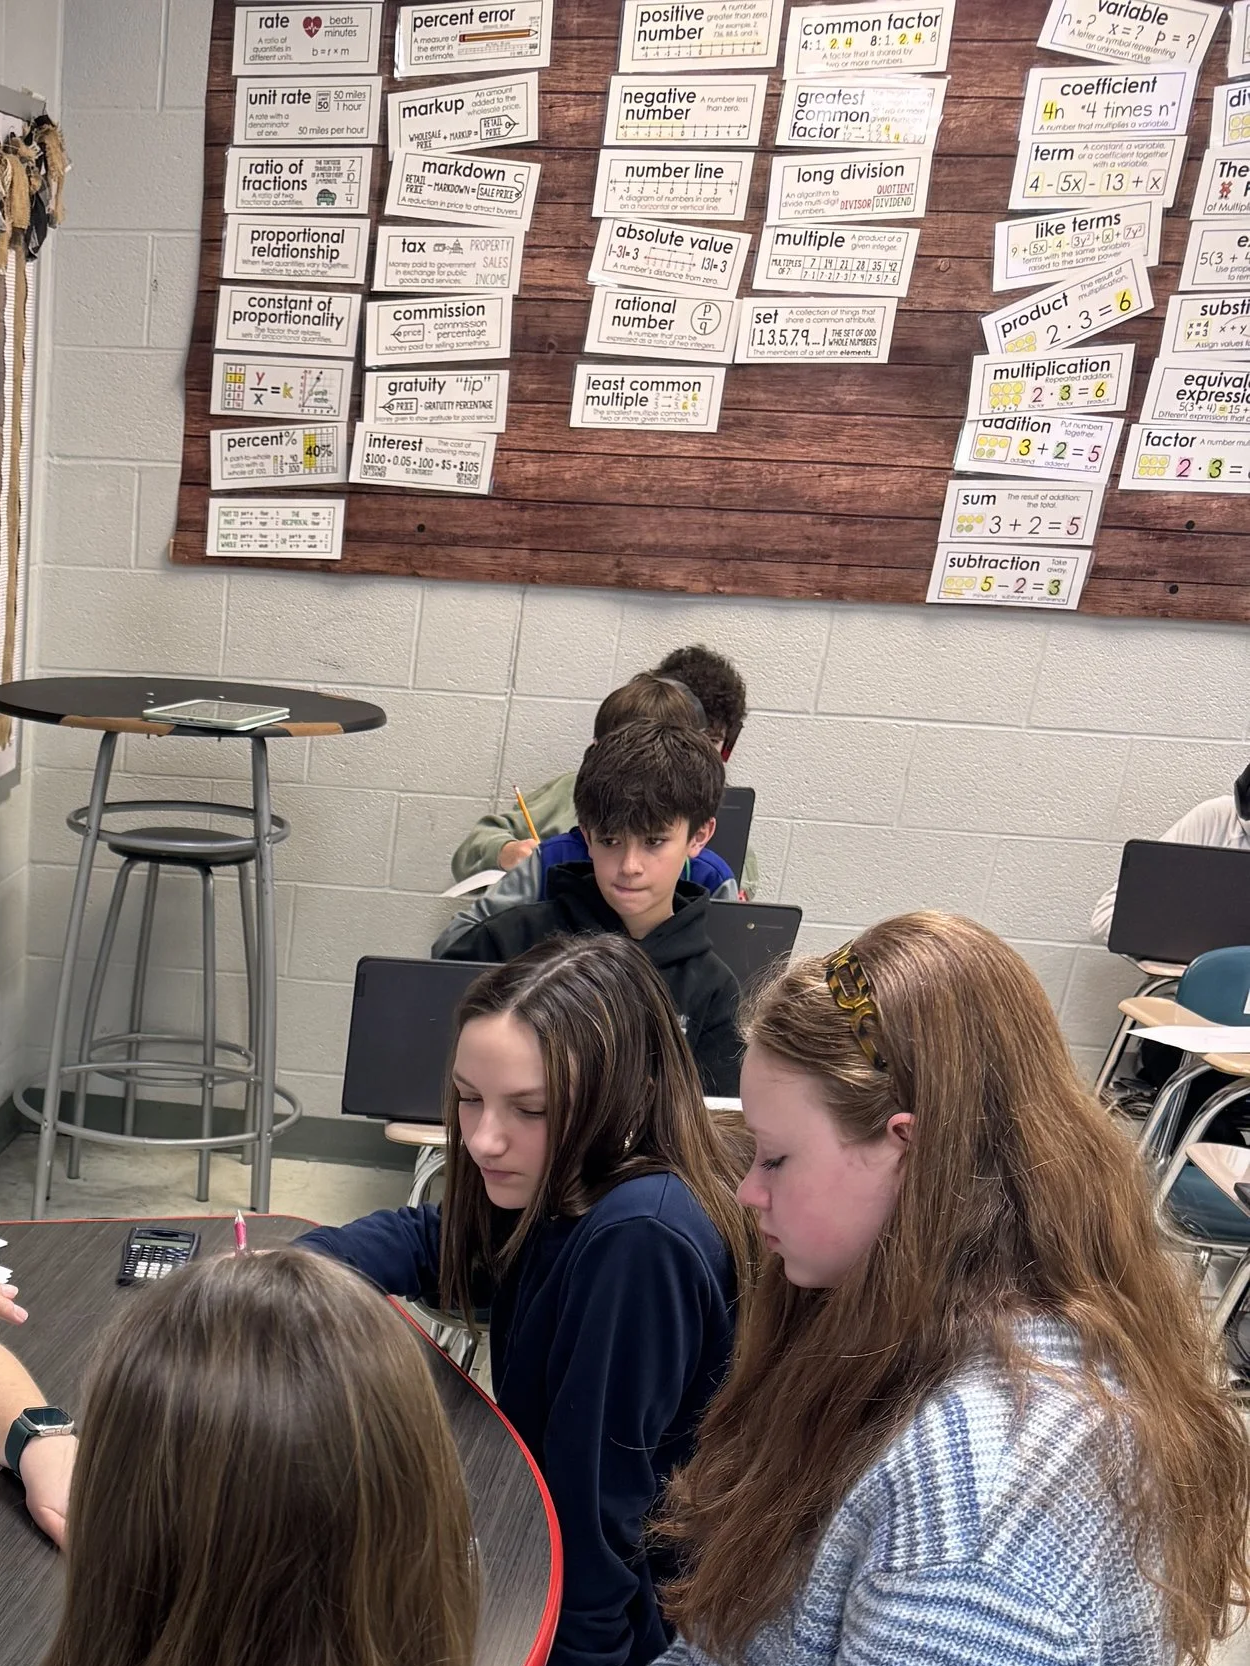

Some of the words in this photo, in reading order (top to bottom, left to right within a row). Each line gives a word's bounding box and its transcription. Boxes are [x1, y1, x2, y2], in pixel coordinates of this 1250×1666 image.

[259, 13, 290, 29] rate
[330, 16, 353, 25] beats
[413, 9, 474, 32] percent
[479, 9, 515, 23] error
[640, 5, 704, 27] positive
[1098, 0, 1168, 26] variable
[803, 19, 882, 35] common
[887, 12, 940, 30] factor
[324, 28, 357, 37] minutes
[420, 35, 450, 43] measure
[638, 24, 704, 41] number
[418, 45, 429, 53] the
[1060, 76, 1158, 96] coefficient
[249, 90, 278, 105] unit
[281, 89, 311, 105] rate
[334, 91, 343, 99] 50
[345, 91, 366, 99] miles
[623, 88, 696, 107] negative
[797, 89, 865, 108] greatest
[318, 101, 328, 109] 50
[343, 103, 361, 111] hour
[402, 98, 464, 118] markup
[625, 105, 691, 120] number
[1043, 101, 1065, 120] 4n
[1104, 102, 1152, 118] times
[484, 118, 503, 128] RETAIL
[795, 108, 870, 122] common
[309, 126, 328, 134] miles
[331, 126, 344, 138] per
[346, 125, 364, 134] hour
[409, 130, 441, 142] WHOLESALE
[450, 130, 472, 141] MARKUP
[485, 128, 501, 137] PRICE
[791, 122, 840, 139] factor
[1034, 145, 1074, 161] term
[249, 160, 283, 174] ratio
[289, 160, 304, 174] of
[422, 161, 506, 181] markdown
[625, 163, 689, 178] number
[694, 163, 724, 178] line
[797, 168, 834, 185] long
[840, 162, 905, 180] division
[242, 176, 307, 191] fractions
[405, 174, 426, 185] RETAIL
[1029, 175, 1040, 192] 4
[1060, 174, 1082, 192] 5x
[1105, 173, 1124, 191] 13
[405, 184, 423, 194] PRICE
[433, 182, 470, 195] MARKDOWN
[479, 187, 496, 198] SALE
[496, 189, 513, 199] PRICE
[877, 183, 915, 194] QUOTIENT
[840, 200, 872, 210] DIVISOR
[875, 197, 912, 208] DIVIDEND
[1035, 221, 1065, 238] like
[1072, 213, 1121, 232] terms
[250, 228, 345, 245] proportional
[616, 224, 684, 246] absolute
[690, 236, 733, 254] value
[775, 230, 846, 251] multiple
[252, 243, 340, 262] relationship
[401, 238, 426, 253] tax
[471, 239, 510, 251] PROPERTY
[483, 256, 508, 268] SALES
[772, 259, 802, 268] MULTIPLES
[810, 258, 816, 268] 7
[825, 259, 833, 268] 14
[840, 260, 849, 270] 21
[856, 261, 865, 270] 28
[872, 261, 881, 271] 35
[888, 262, 897, 272] 42
[475, 273, 507, 285] INCOME
[248, 296, 312, 311] constant
[317, 298, 332, 312] of
[393, 302, 485, 321] commission
[615, 297, 676, 314] rational
[232, 310, 344, 331] proportionality
[611, 314, 674, 330] number
[754, 309, 778, 324] set
[1001, 293, 1068, 338] product
[1046, 324, 1061, 345] 2
[1079, 310, 1092, 329] 3
[1119, 291, 1132, 312] 6
[403, 328, 421, 337] price
[434, 320, 487, 330] commission
[436, 329, 486, 340] percentage
[832, 329, 842, 337] THE
[843, 329, 855, 337] SET
[856, 329, 863, 337] OF
[828, 338, 849, 346] WHOLE
[849, 338, 877, 346] NUMBERS
[993, 358, 1111, 381] multiplication
[256, 372, 265, 386] y
[388, 378, 446, 396] gratuity
[587, 376, 624, 390] least
[630, 380, 701, 392] common
[282, 382, 293, 399] k
[396, 402, 413, 410] PRICE
[424, 400, 454, 410] GRATUITY
[456, 400, 493, 410] PERCENTAGE
[585, 392, 649, 409] multiple
[368, 434, 423, 452] interest
[1145, 432, 1196, 447] factor
[306, 444, 333, 458] 40%
[962, 494, 996, 505] sum
[989, 516, 1002, 534] 3
[1028, 516, 1042, 534] 2
[1066, 517, 1081, 535] 5
[948, 555, 1040, 572] subtraction
[981, 576, 994, 592] 5
[1014, 578, 1026, 593] 2
[1049, 579, 1061, 595] 3
